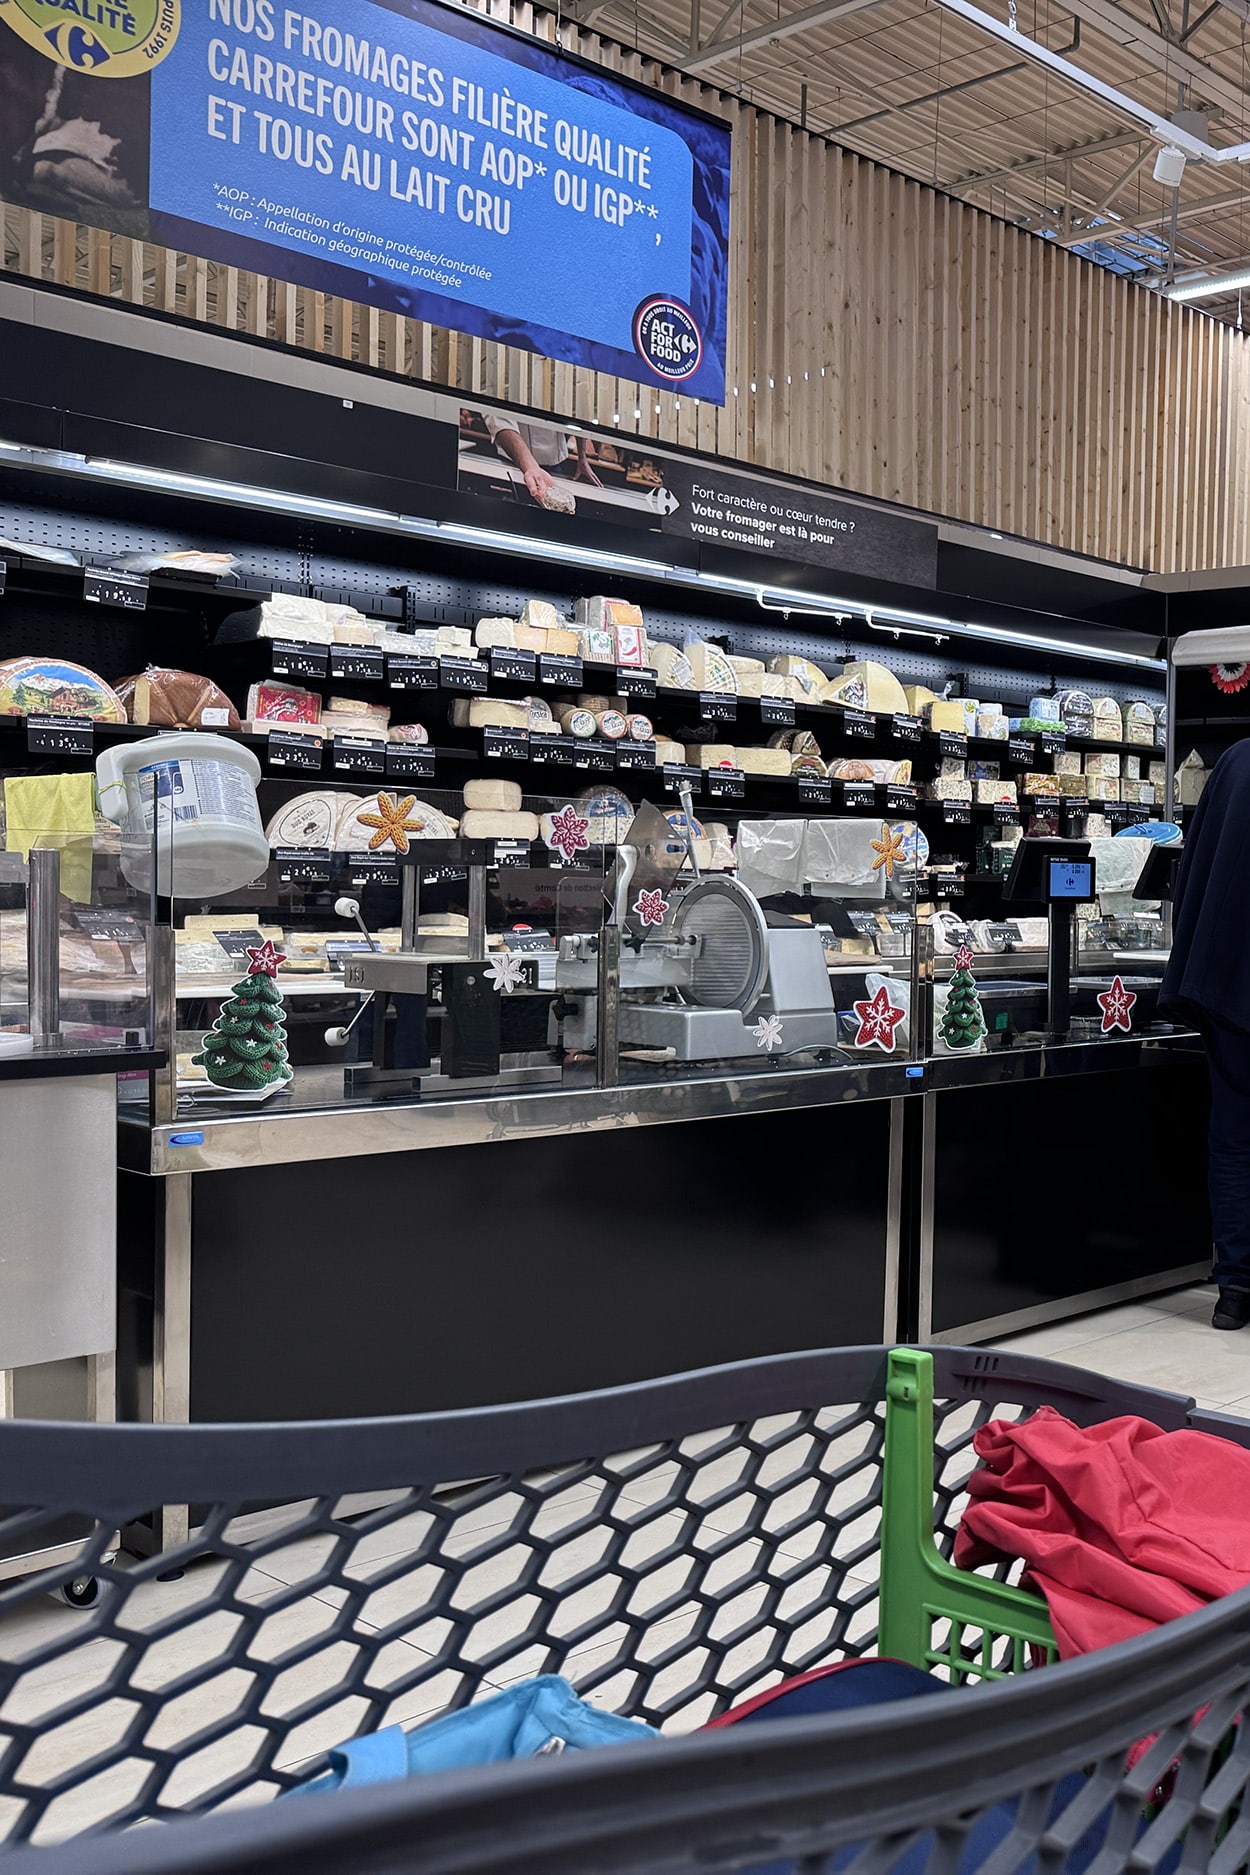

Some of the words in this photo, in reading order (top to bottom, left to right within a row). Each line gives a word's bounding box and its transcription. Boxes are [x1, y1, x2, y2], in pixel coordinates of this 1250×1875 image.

[35, 0, 136, 37] ALITÉ
[142, 32, 168, 59] 1992
[209, 0, 275, 42] NOS
[283, 9, 444, 107] FROMAGES
[452, 76, 548, 149] FILIÈRE
[555, 119, 651, 189] QUALITÉ
[208, 38, 394, 143] CARREFOUR
[402, 111, 475, 170] SONT
[554, 169, 588, 212] OU
[207, 94, 247, 145] ET
[254, 110, 333, 176] TOUS
[341, 143, 381, 191] AU
[390, 158, 450, 215] LAIT
[457, 184, 511, 235] CRU
[257, 198, 330, 229] Appellation
[386, 240, 493, 281] protégée/contrôlée
[264, 218, 326, 246] Indication
[328, 239, 409, 272] géographique
[411, 265, 462, 289] protégée
[650, 331, 673, 349] FOR
[651, 319, 675, 337] ACT
[650, 343, 682, 362] FOOD
[691, 502, 723, 520] Votre
[725, 510, 777, 532] fromager
[779, 523, 796, 537] est
[798, 526, 808, 539] là
[810, 531, 835, 545] pour
[692, 484, 715, 501] Fort
[717, 492, 767, 513] caractère
[770, 505, 783, 516] ou
[786, 509, 812, 524] cœur
[815, 514, 847, 532] tendre
[849, 521, 856, 533] ?
[690, 522, 719, 537] vous
[721, 528, 775, 549] conseiller
